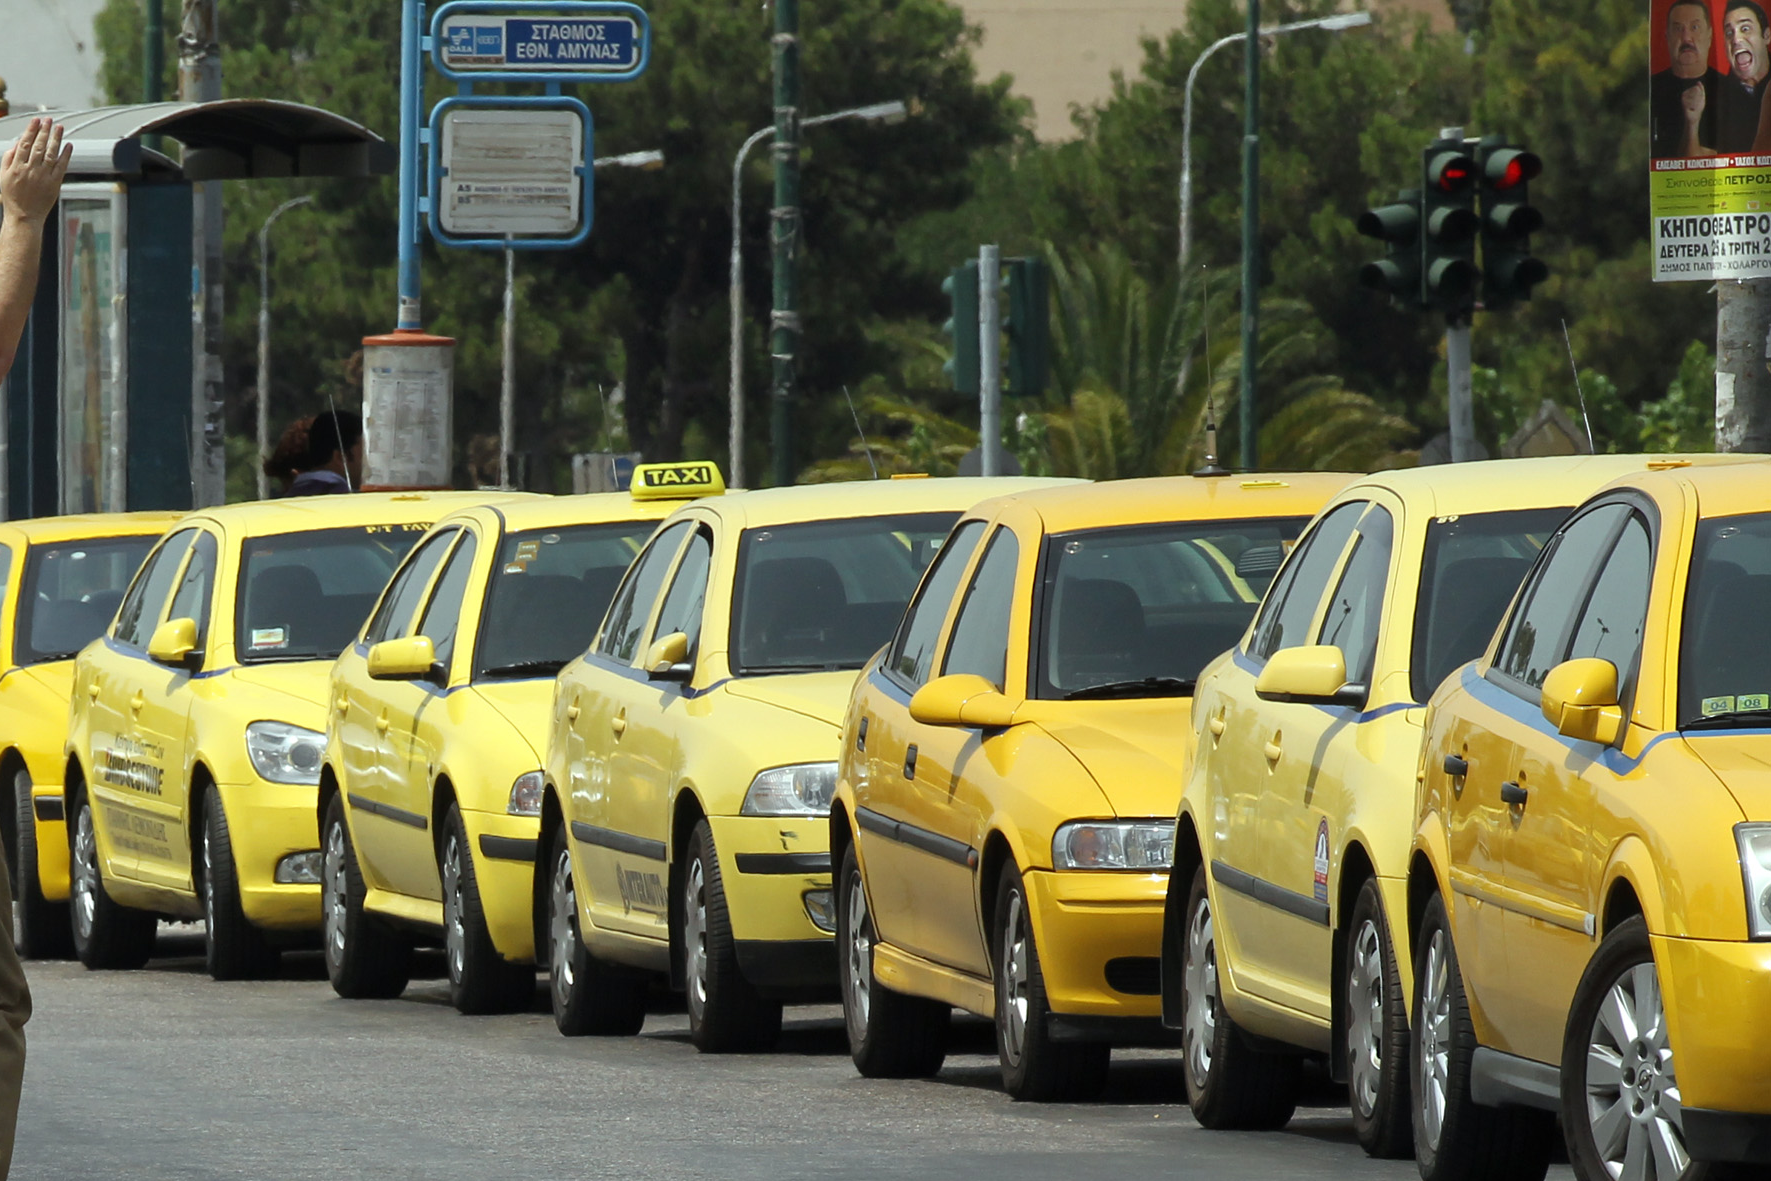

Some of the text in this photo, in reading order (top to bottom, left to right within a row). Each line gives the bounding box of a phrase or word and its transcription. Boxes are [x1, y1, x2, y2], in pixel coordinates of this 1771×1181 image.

[531, 25, 606, 41] ΣΤΑΘΜΟΣ
[516, 42, 620, 59] ΕΘΝ. ΑΜΥΝΑΣ
[1660, 243, 1709, 259] ΔΕΥΤΕΡΑ
[1729, 241, 1760, 256] ΤΡΙΤΗ
[1660, 262, 1691, 273] ΔΗΜΟΣ
[647, 467, 709, 486] TAXI
[1710, 700, 1727, 710] 04
[1744, 698, 1761, 707] 08
